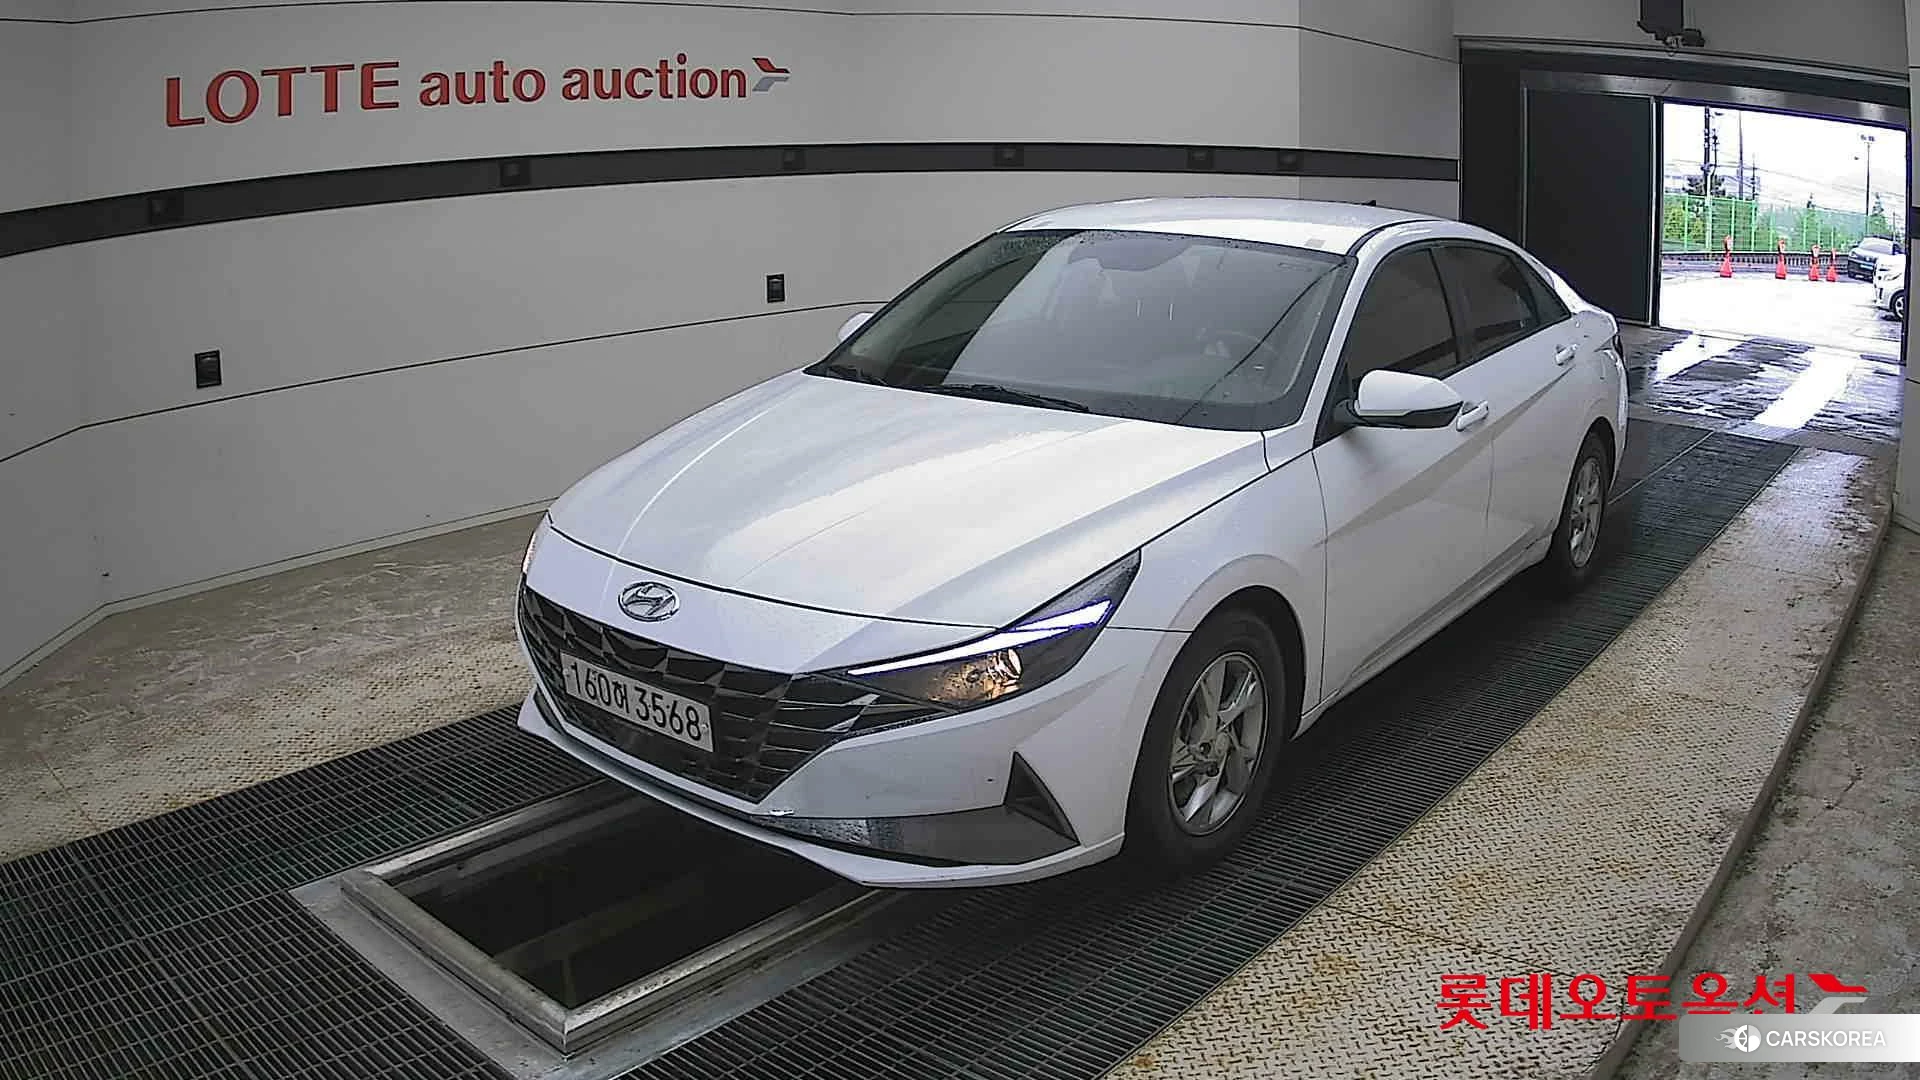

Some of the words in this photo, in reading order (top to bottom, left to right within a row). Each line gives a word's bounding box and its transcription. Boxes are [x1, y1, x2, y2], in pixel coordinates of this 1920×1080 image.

[165, 61, 400, 128] LOTTE
[419, 60, 546, 106] auto
[562, 53, 748, 100] auction
[570, 661, 631, 714] 160허
[633, 686, 702, 742] 3568
